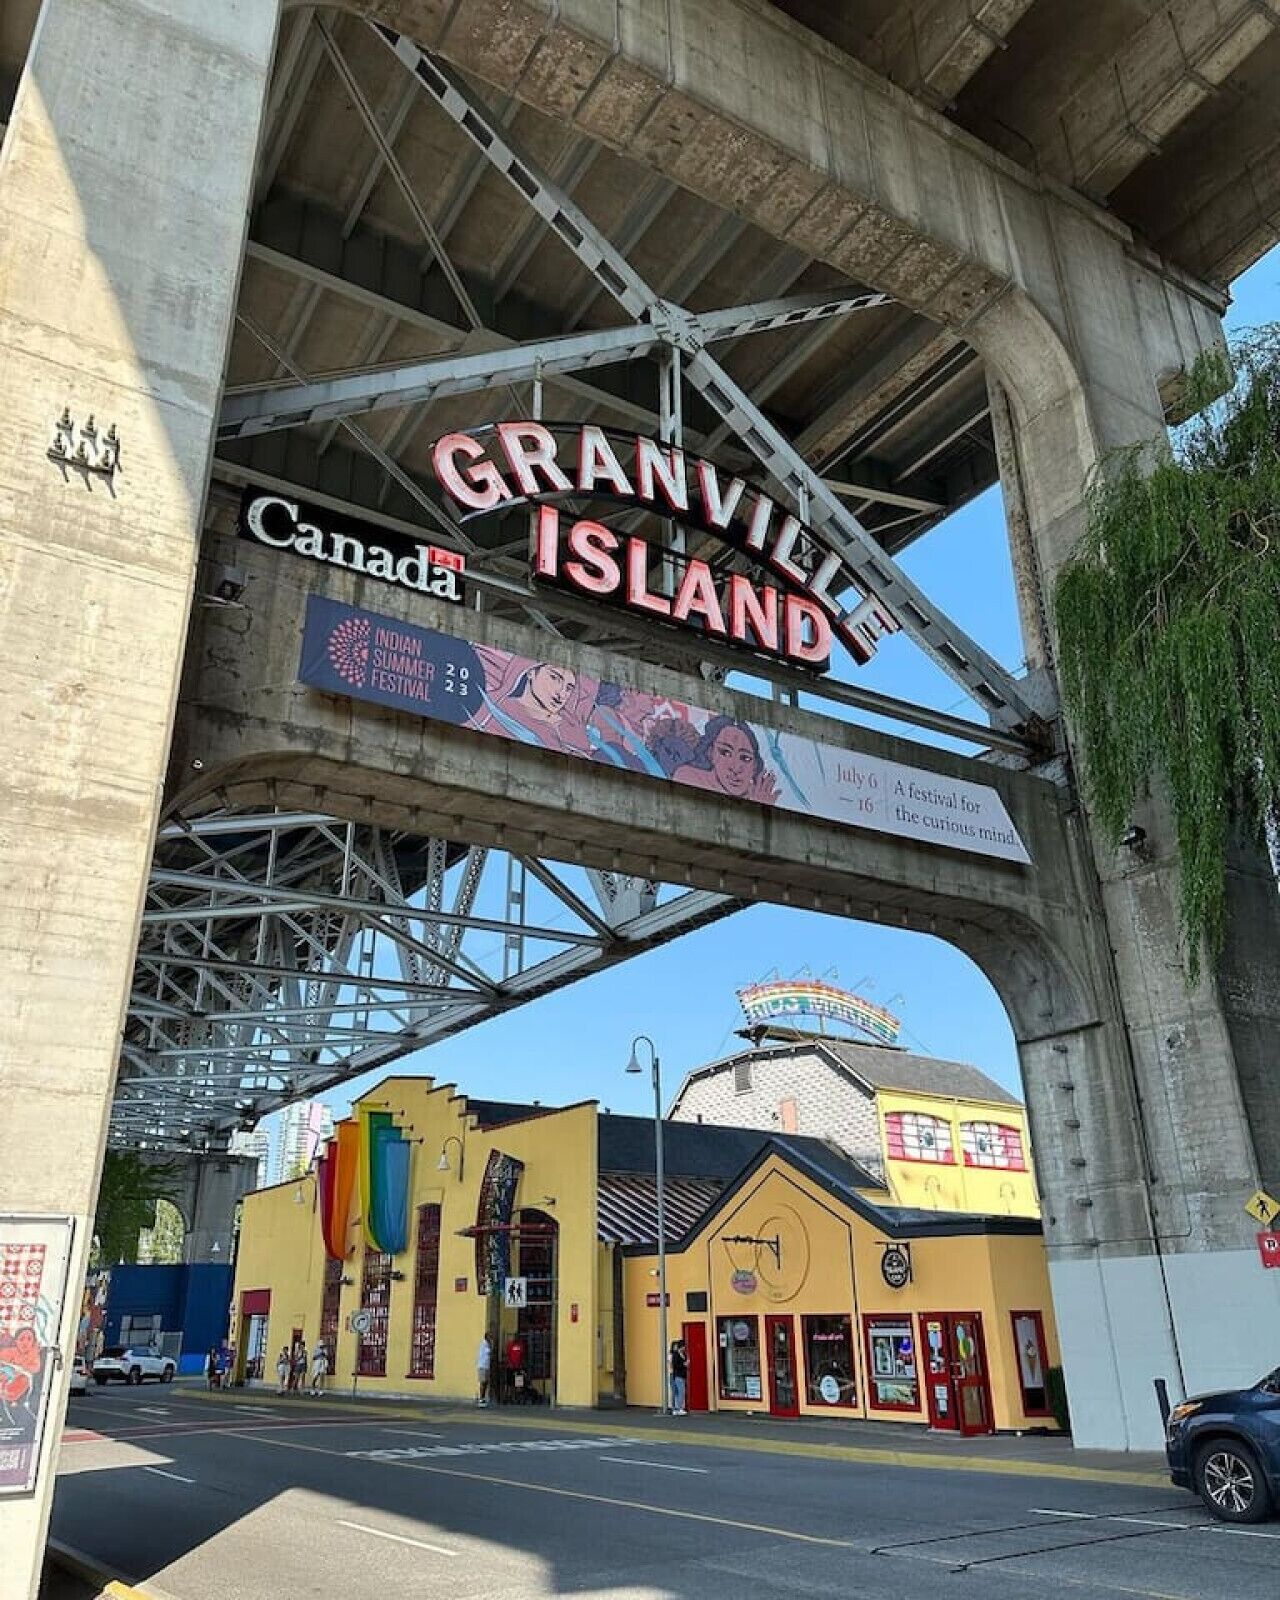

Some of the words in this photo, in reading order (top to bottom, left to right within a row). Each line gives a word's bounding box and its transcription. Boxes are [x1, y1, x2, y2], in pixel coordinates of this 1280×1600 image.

[246, 495, 462, 601] Canada
[432, 421, 903, 666] GRANVILLE
[535, 503, 832, 664] ISLAND
[375, 627, 423, 657] INDIAN
[373, 649, 436, 681] SUMMER
[371, 669, 432, 702] FESTIVAL
[837, 763, 865, 790] July
[867, 772, 878, 789] 6
[858, 798, 874, 814] 16
[894, 779, 906, 797] A
[907, 782, 958, 809] festival
[961, 795, 981, 815] for
[896, 805, 920, 824] the
[922, 815, 976, 838] curious
[979, 826, 1019, 846] mind.
